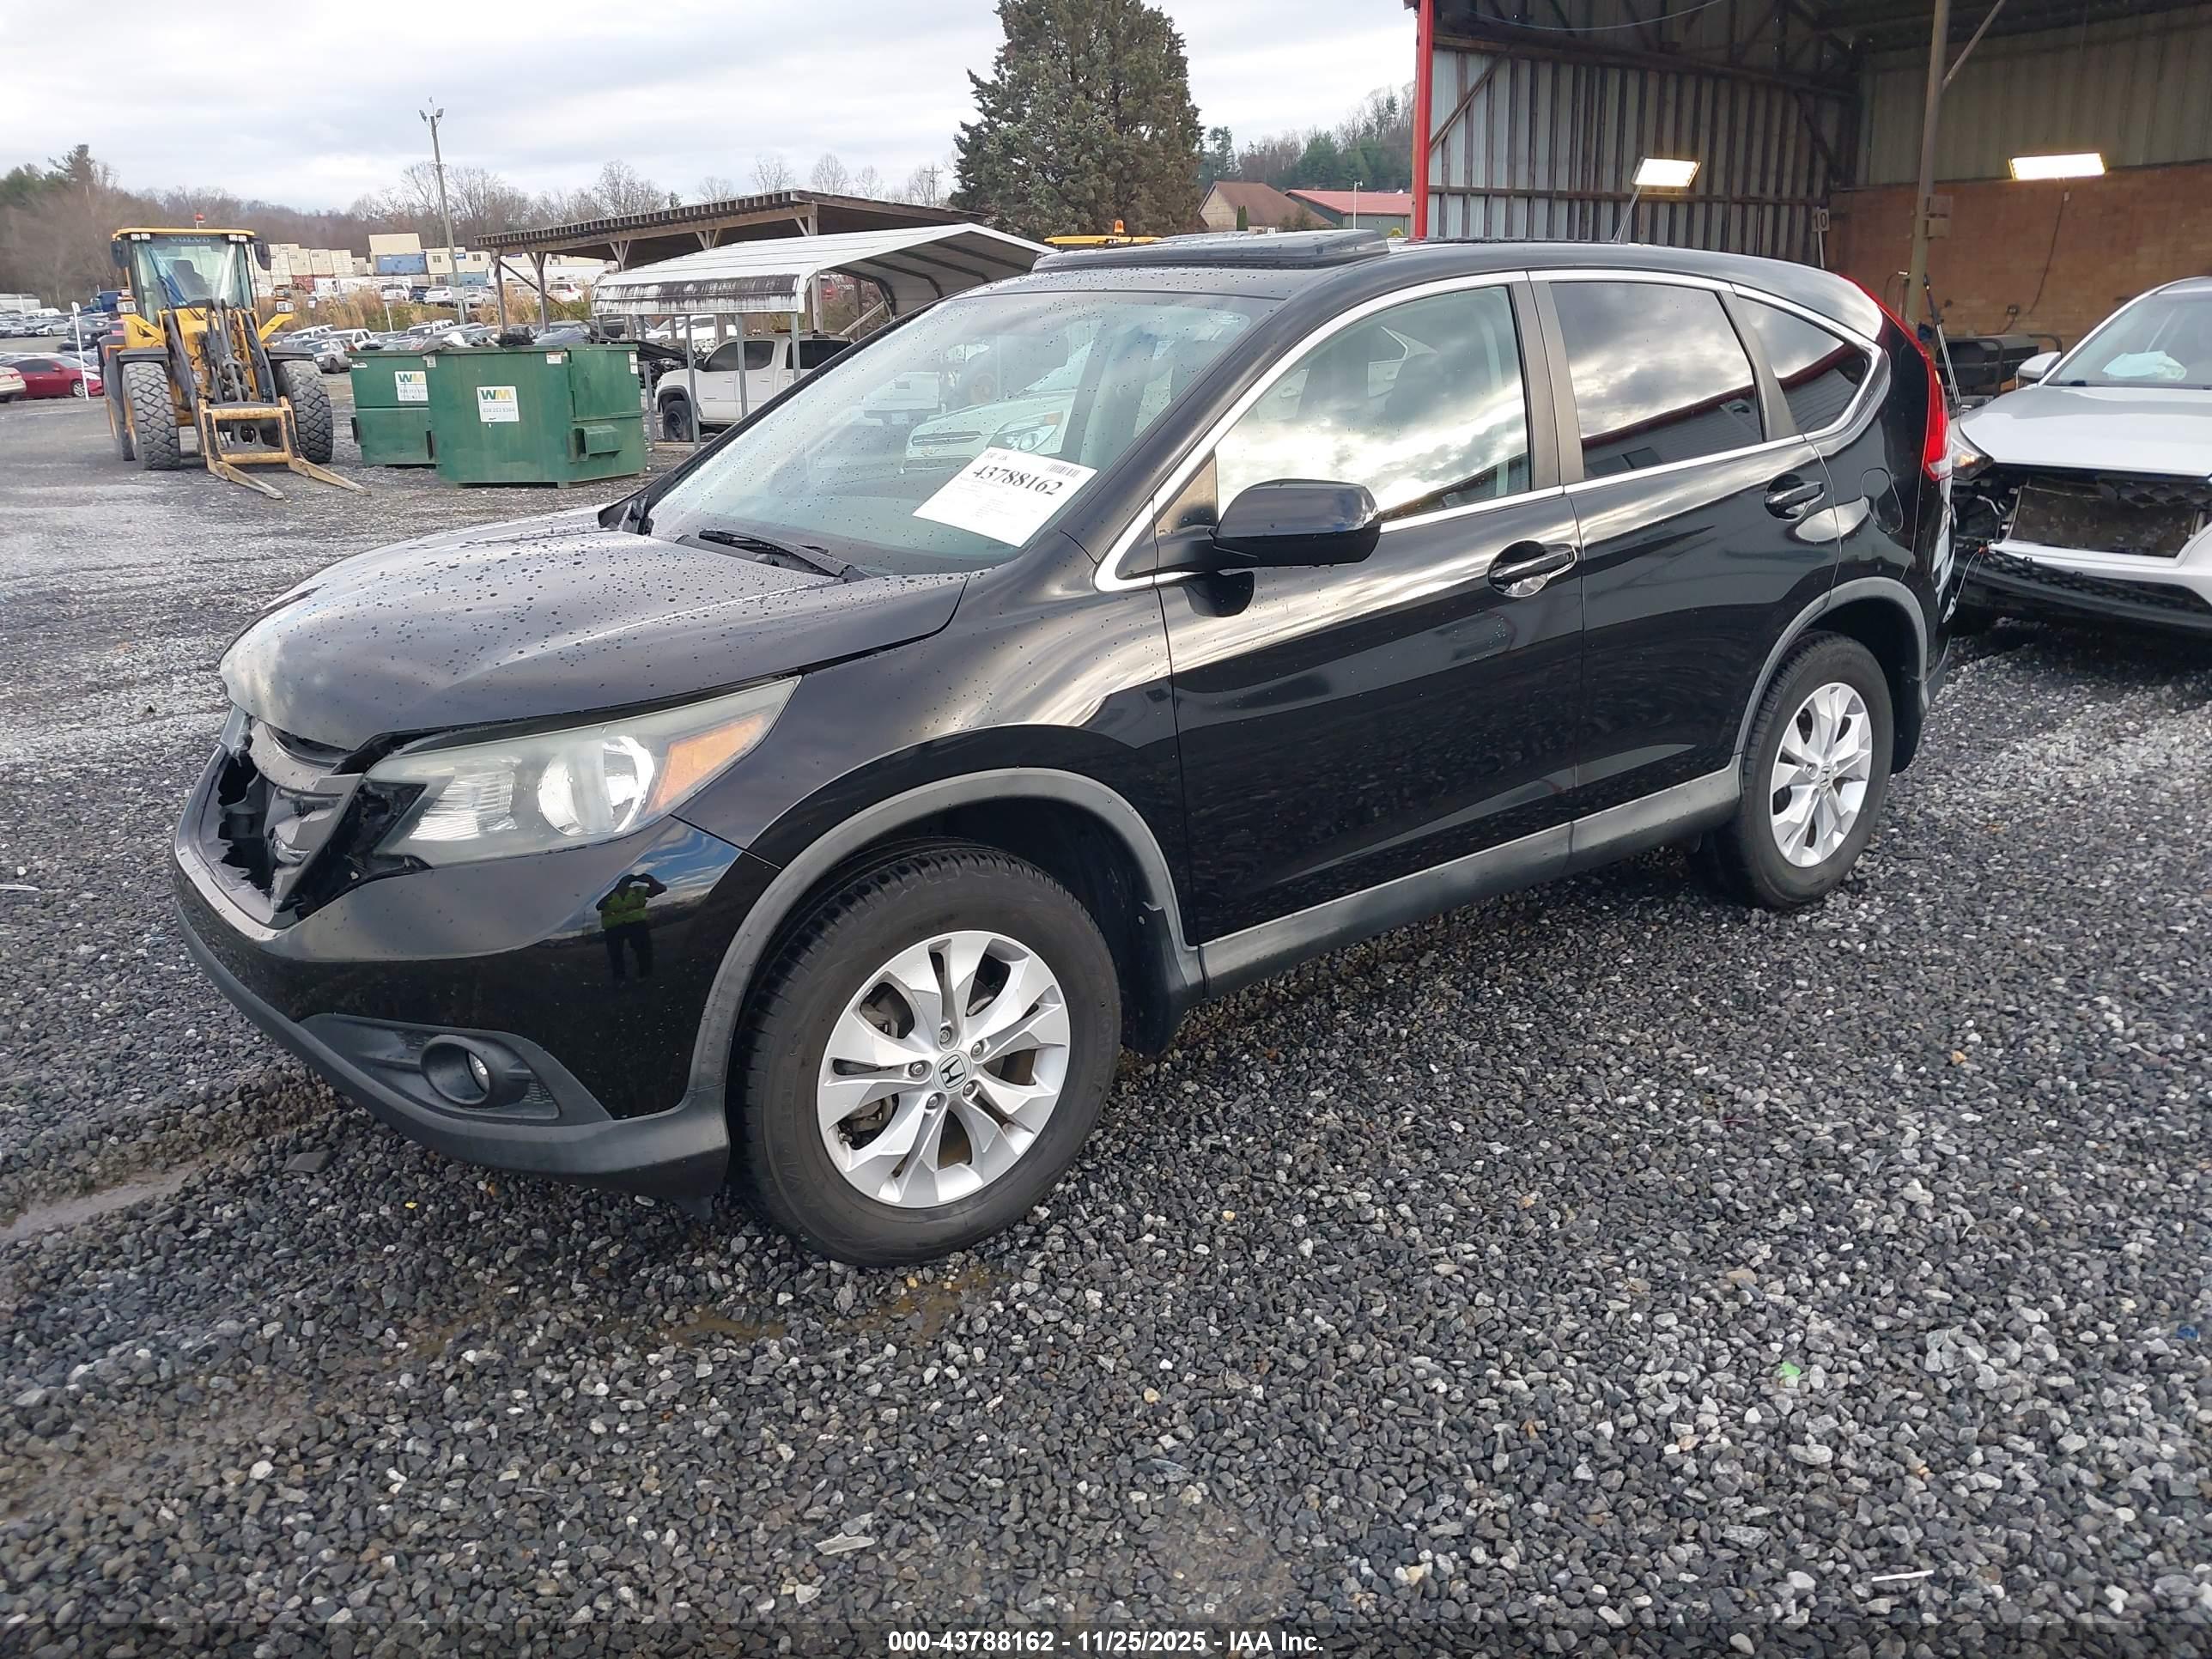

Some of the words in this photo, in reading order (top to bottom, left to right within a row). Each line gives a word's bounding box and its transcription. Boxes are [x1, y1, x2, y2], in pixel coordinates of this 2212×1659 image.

[1813, 212, 1827, 228] 10
[481, 389, 513, 400] WM
[973, 465, 1063, 495] 43788162
